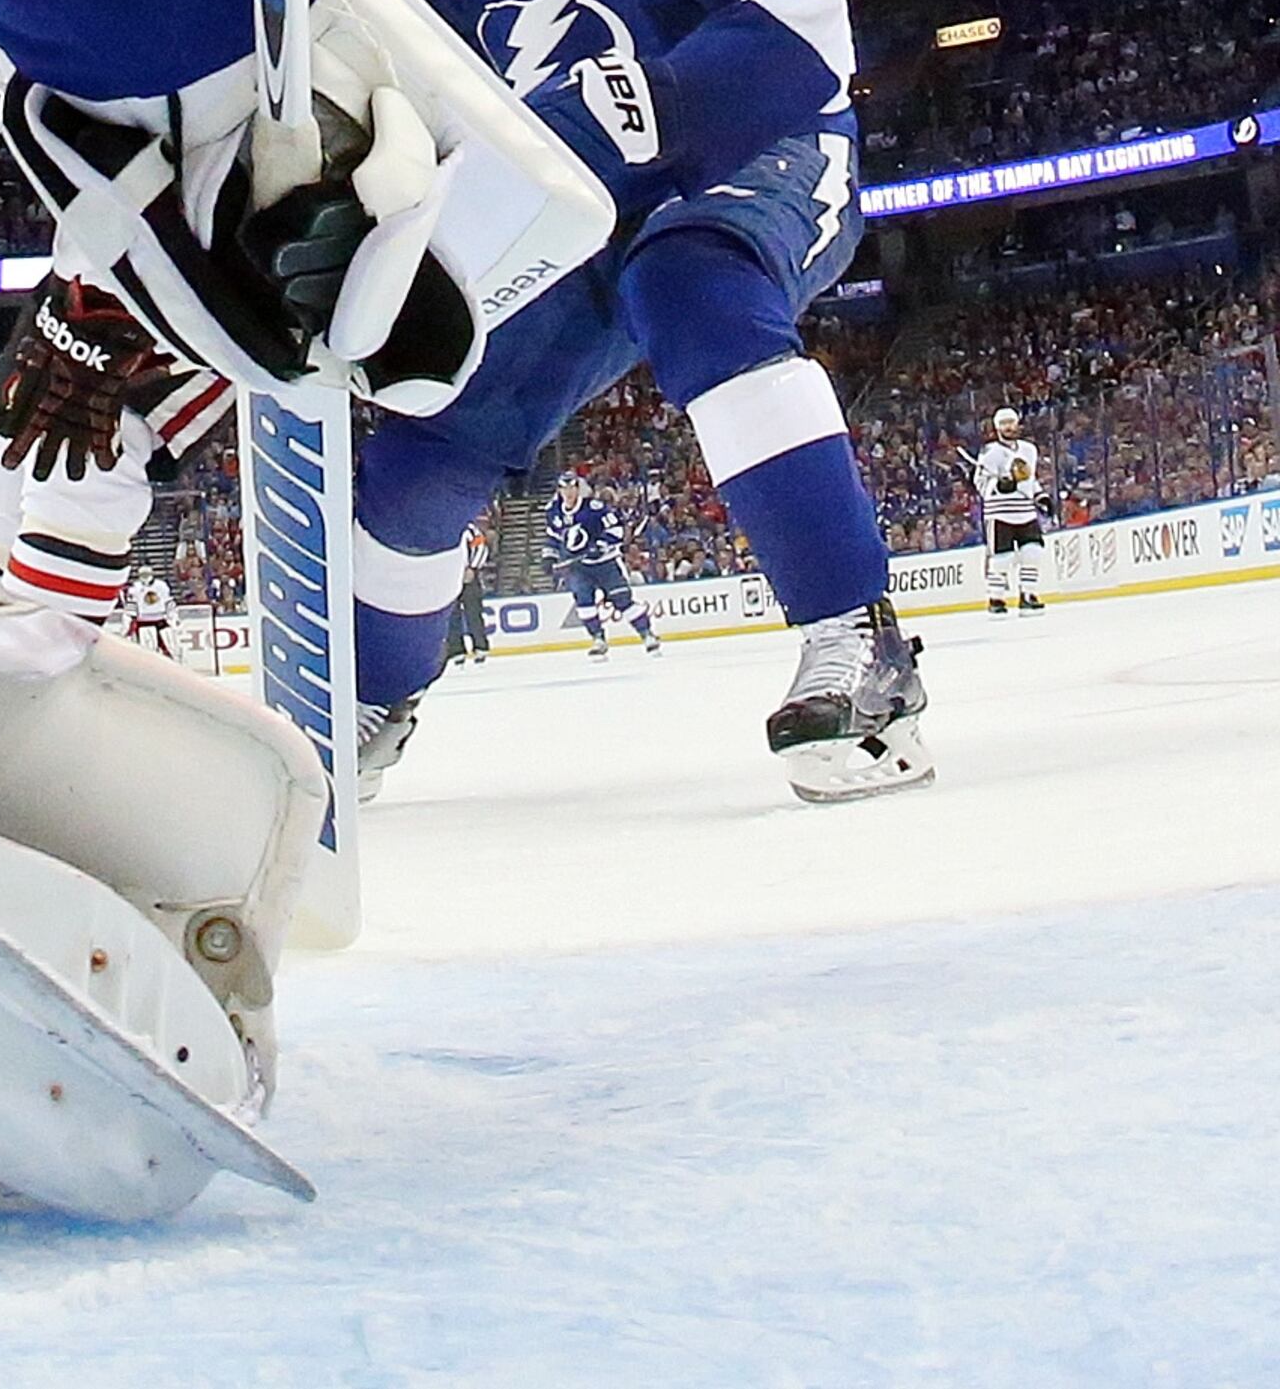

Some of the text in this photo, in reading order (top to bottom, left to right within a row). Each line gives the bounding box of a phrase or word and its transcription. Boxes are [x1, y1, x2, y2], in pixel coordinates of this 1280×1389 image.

[939, 24, 985, 42] CHASE
[592, 55, 645, 133] UER
[860, 135, 1196, 213] ARTNER OF THE TAMPA BAY LIGHTNING
[35, 296, 112, 372] eebok
[1132, 519, 1200, 563] DISCOVER
[1220, 511, 1248, 550] SAP
[888, 563, 964, 593] DGESTONE
[669, 594, 729, 616] LIGHT
